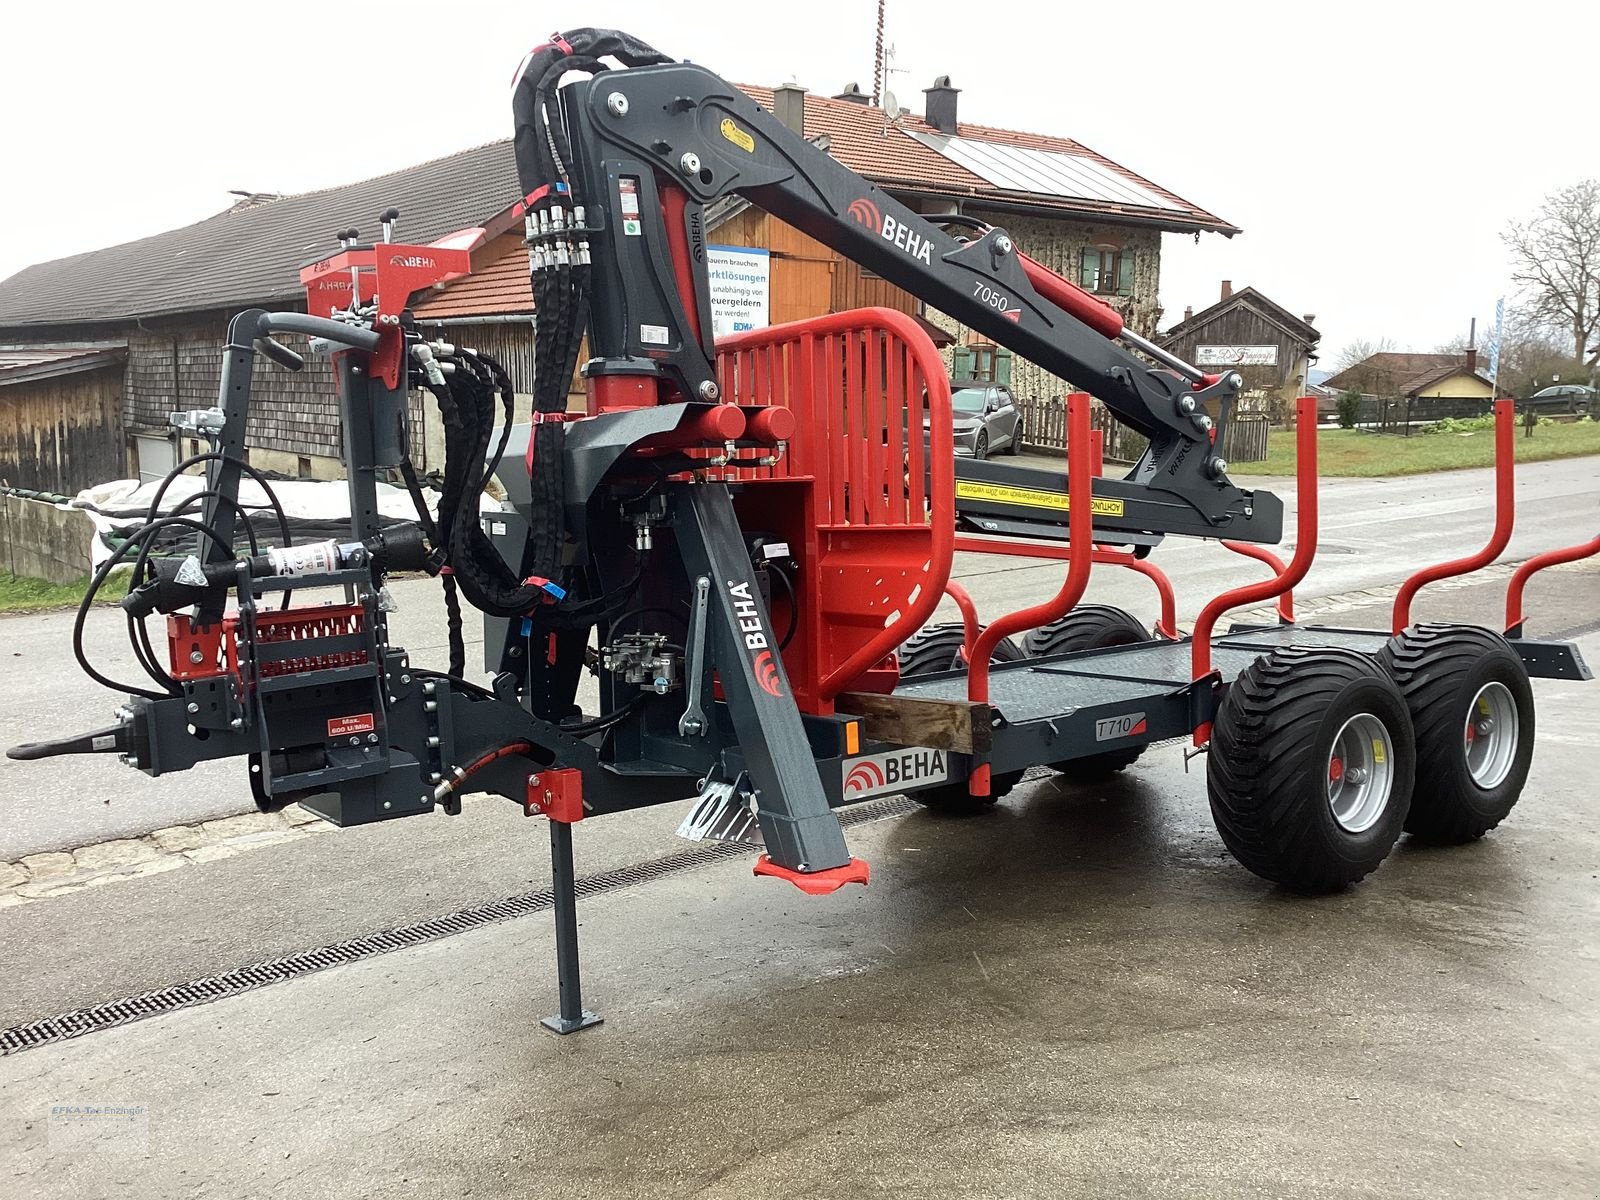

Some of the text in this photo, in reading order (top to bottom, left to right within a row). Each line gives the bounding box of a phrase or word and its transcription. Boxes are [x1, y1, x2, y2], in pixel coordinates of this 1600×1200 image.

[691, 212, 701, 242] BEHA
[881, 214, 932, 266] BEHA
[407, 256, 437, 268] BEHA
[729, 258, 759, 268] brauchen
[708, 270, 766, 284] rktlösungen
[712, 285, 751, 296] unabhängig
[973, 281, 1008, 312] 7050
[711, 297, 762, 308] euergeldern
[724, 309, 750, 318] werden!
[1167, 451, 1185, 476] BEHA
[960, 485, 985, 494] verboten
[729, 581, 768, 650] BEHA
[1098, 717, 1131, 737] T 710
[885, 749, 945, 784] BEHA
